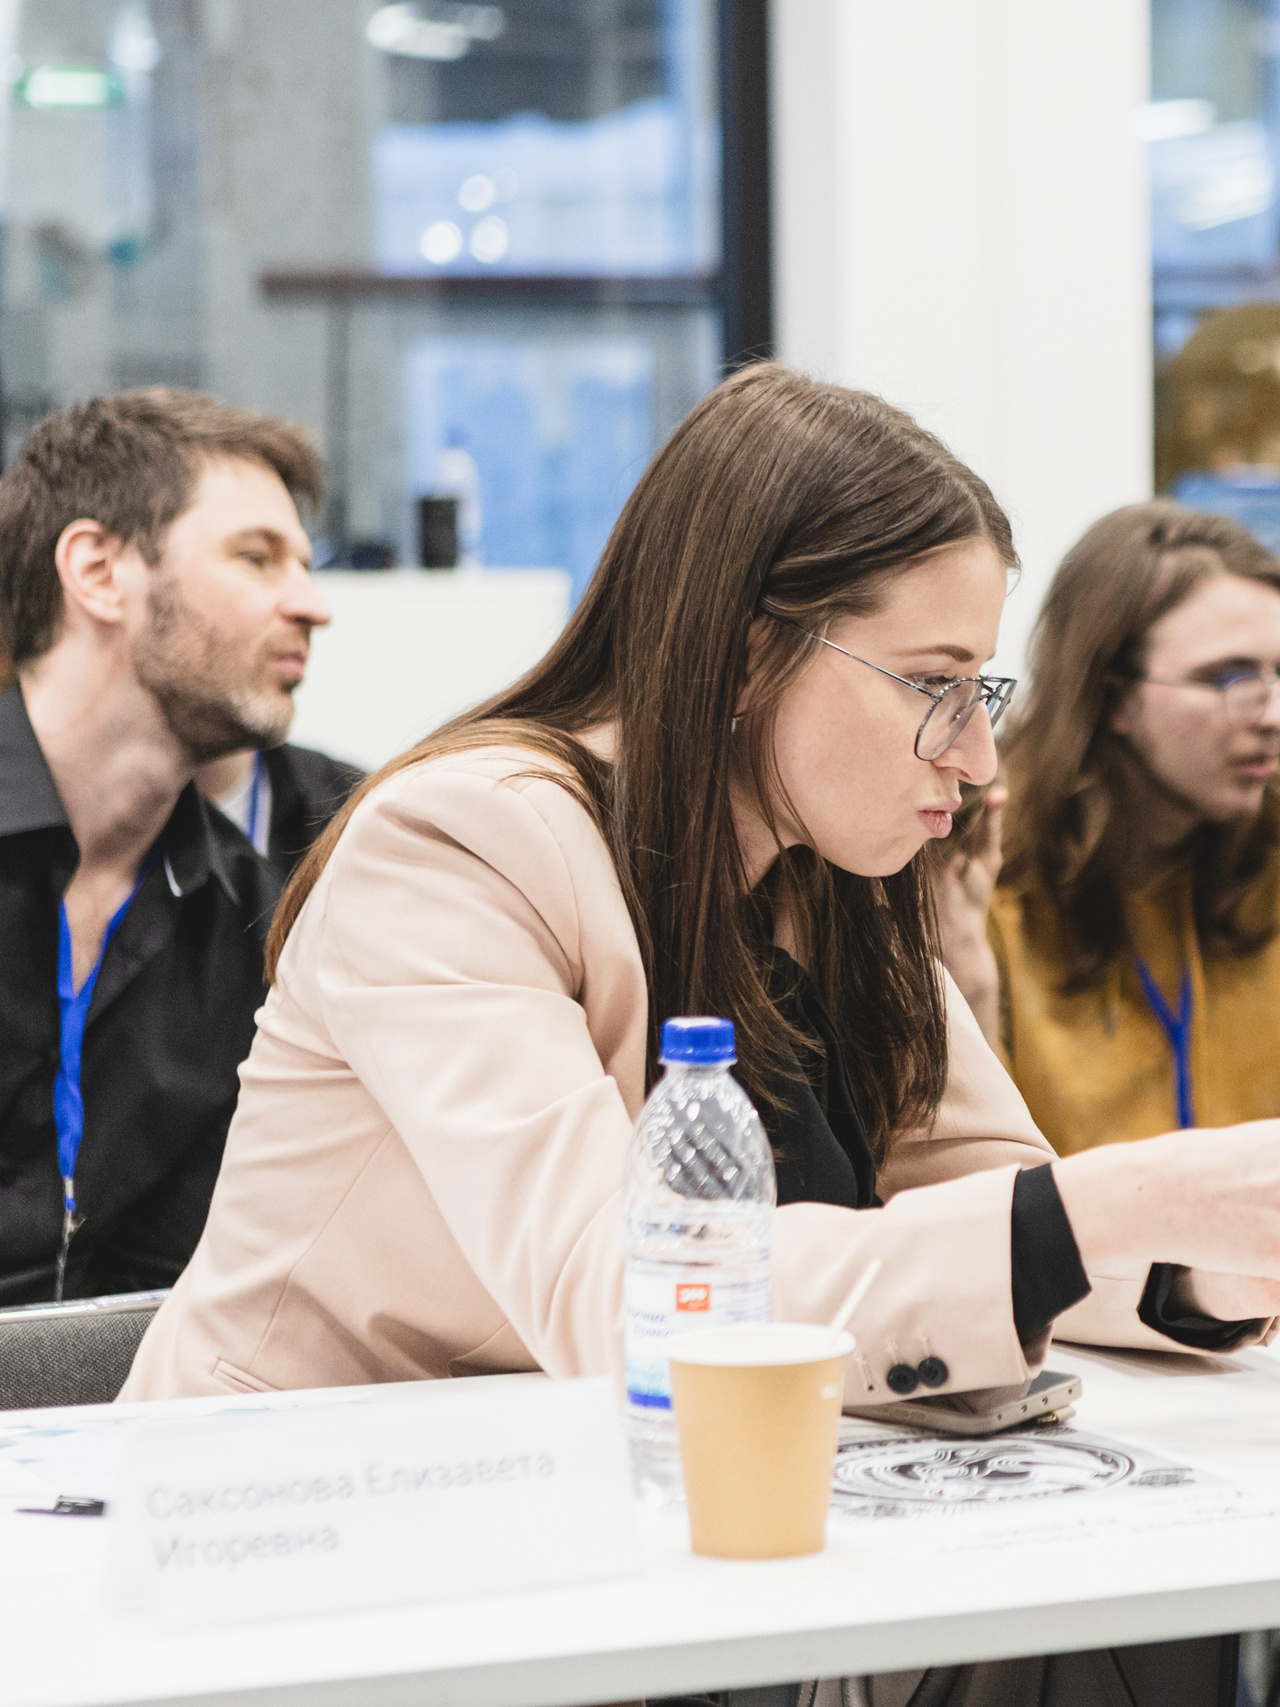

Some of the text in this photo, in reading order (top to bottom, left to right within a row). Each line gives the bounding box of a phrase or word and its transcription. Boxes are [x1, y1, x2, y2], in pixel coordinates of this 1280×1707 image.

[146, 1452, 556, 1521] Саксонова Елизавета
[151, 1524, 341, 1571] Игоревна
